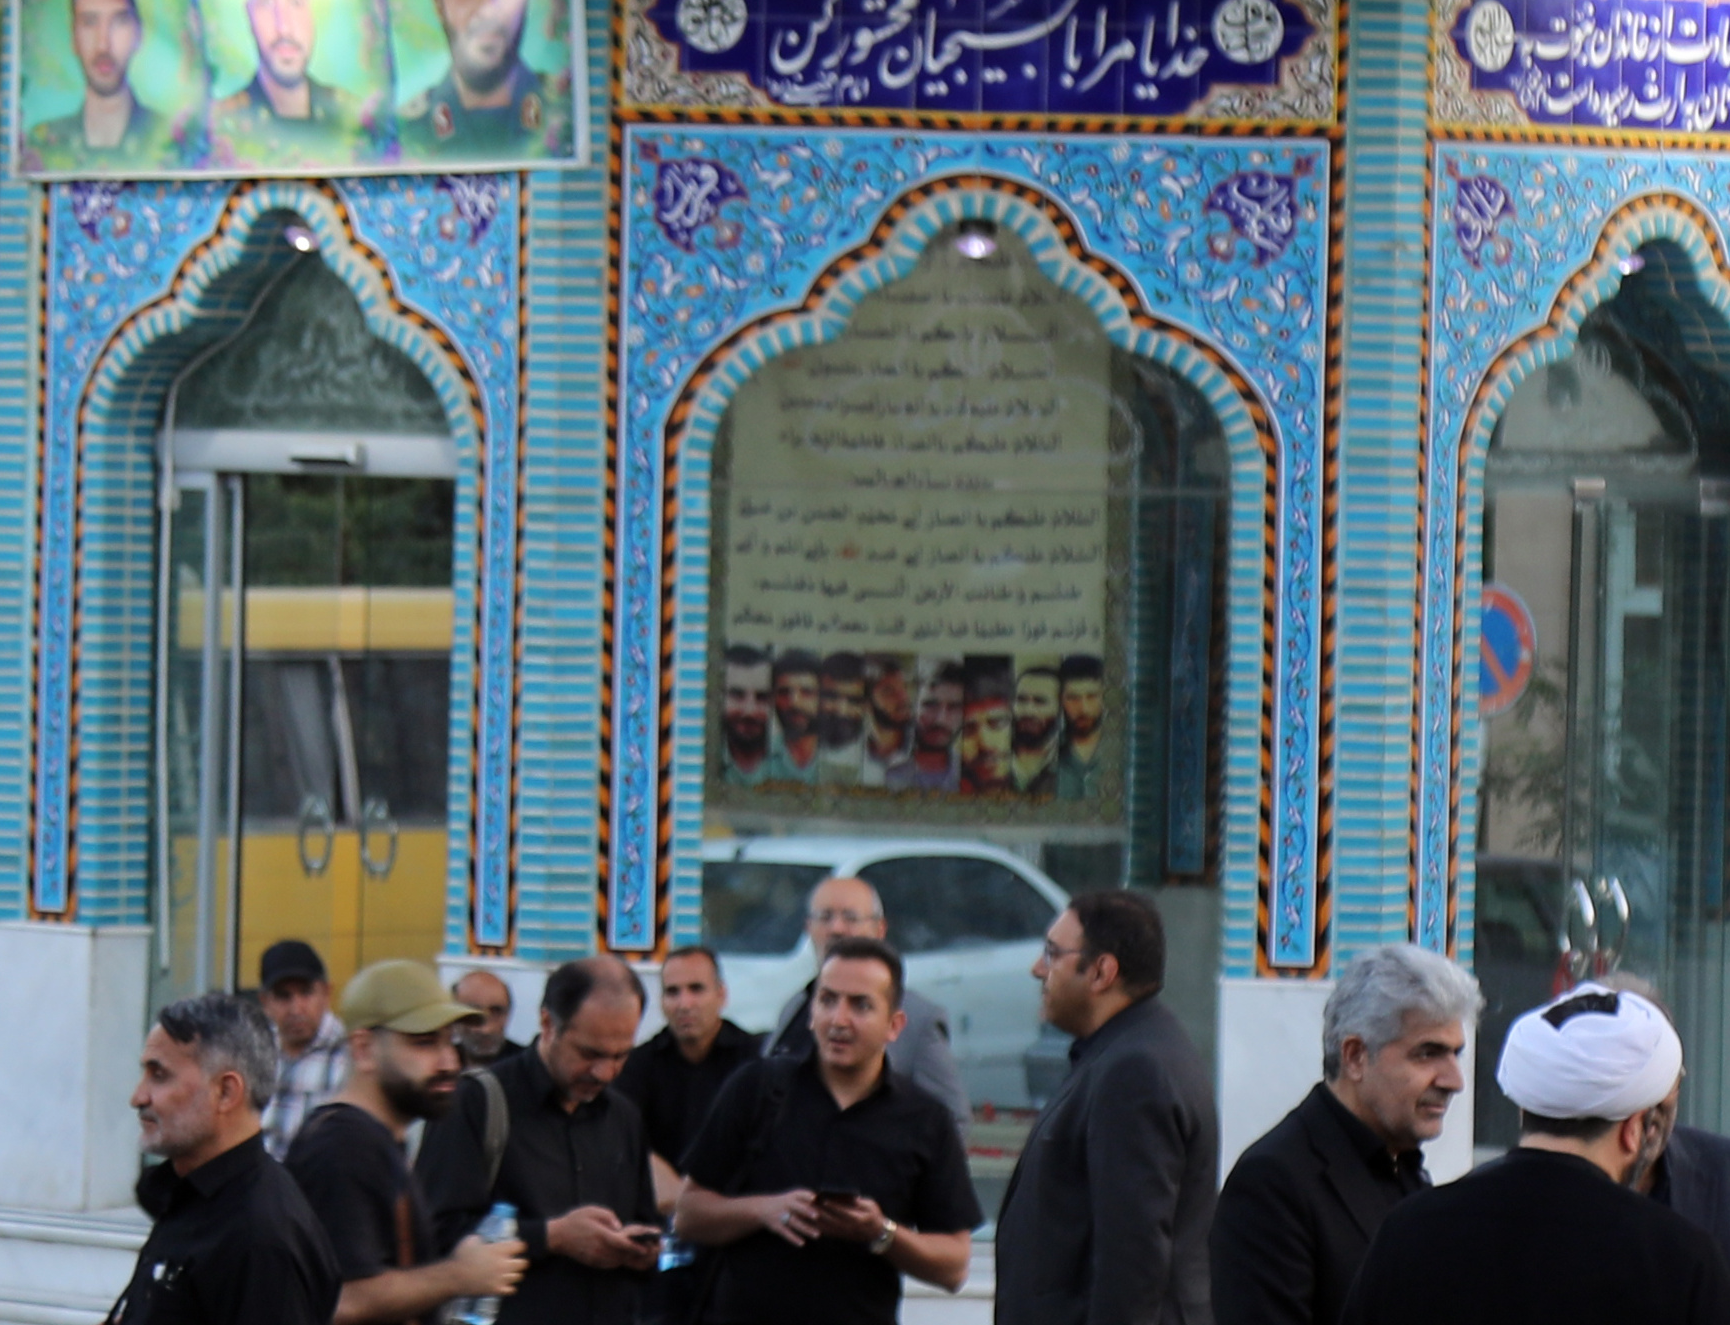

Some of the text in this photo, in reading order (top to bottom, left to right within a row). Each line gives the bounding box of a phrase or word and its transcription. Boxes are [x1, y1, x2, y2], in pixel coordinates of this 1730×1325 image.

[1060, 14, 1082, 90] با
[1076, 6, 1136, 93] مرا
[1590, 9, 1649, 69] خاندان
